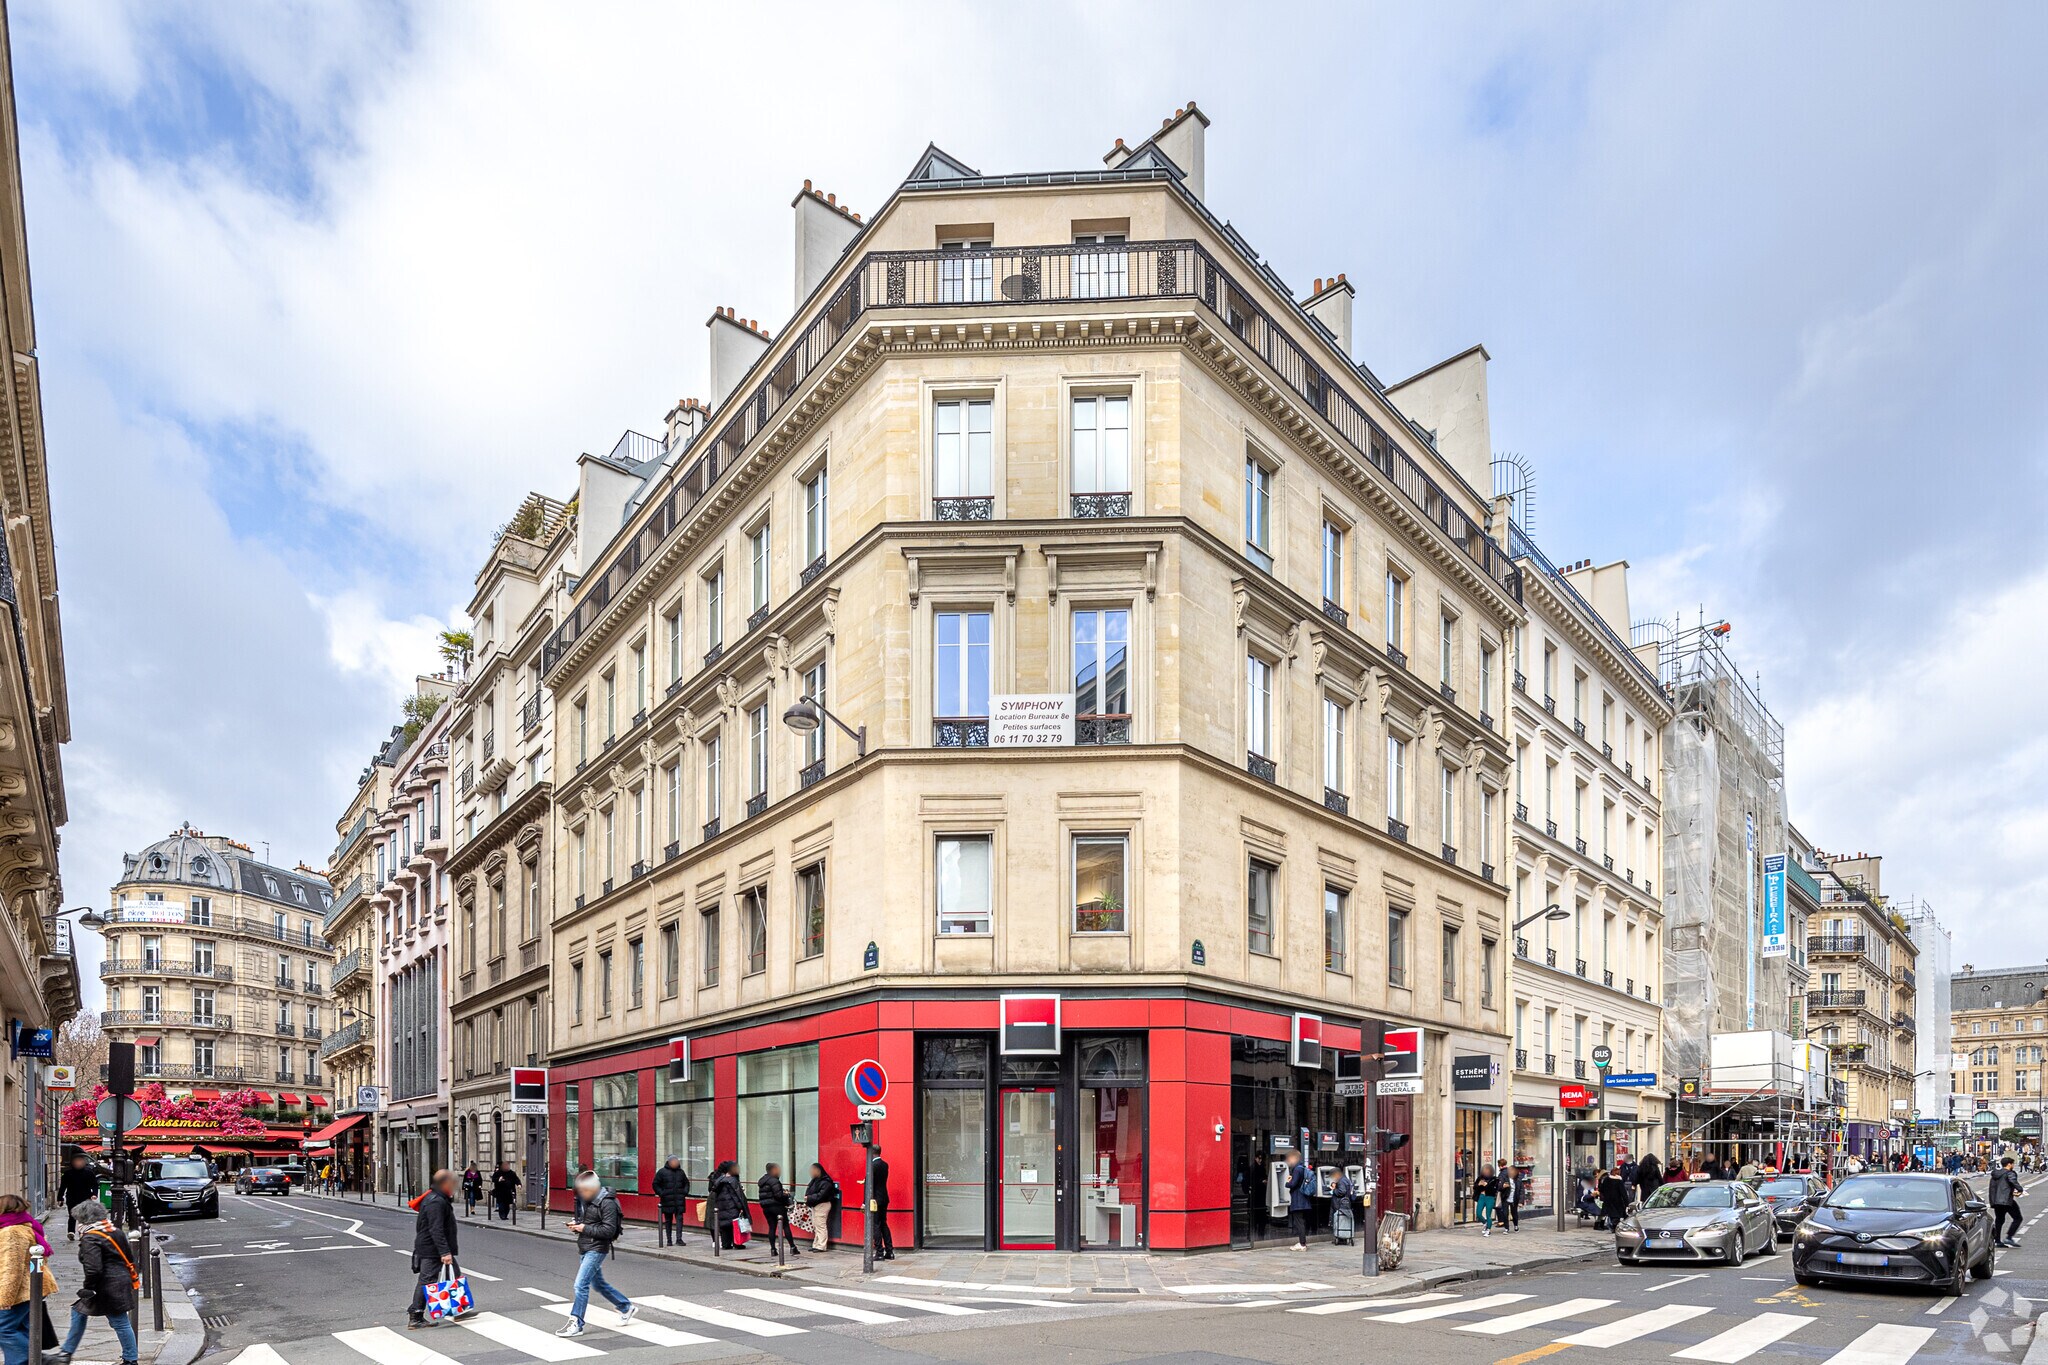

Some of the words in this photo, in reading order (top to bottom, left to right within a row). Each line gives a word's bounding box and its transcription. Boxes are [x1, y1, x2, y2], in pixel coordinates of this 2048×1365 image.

[1001, 701, 1063, 710] SYMPHONY
[994, 735, 1005, 743] 06
[1009, 735, 1018, 743] 11
[1023, 734, 1033, 743] 70
[1036, 734, 1048, 743] 32
[1051, 734, 1062, 743] 79
[1769, 886, 1779, 923] PEREIRA
[1456, 1067, 1488, 1076] ESTHÊME
